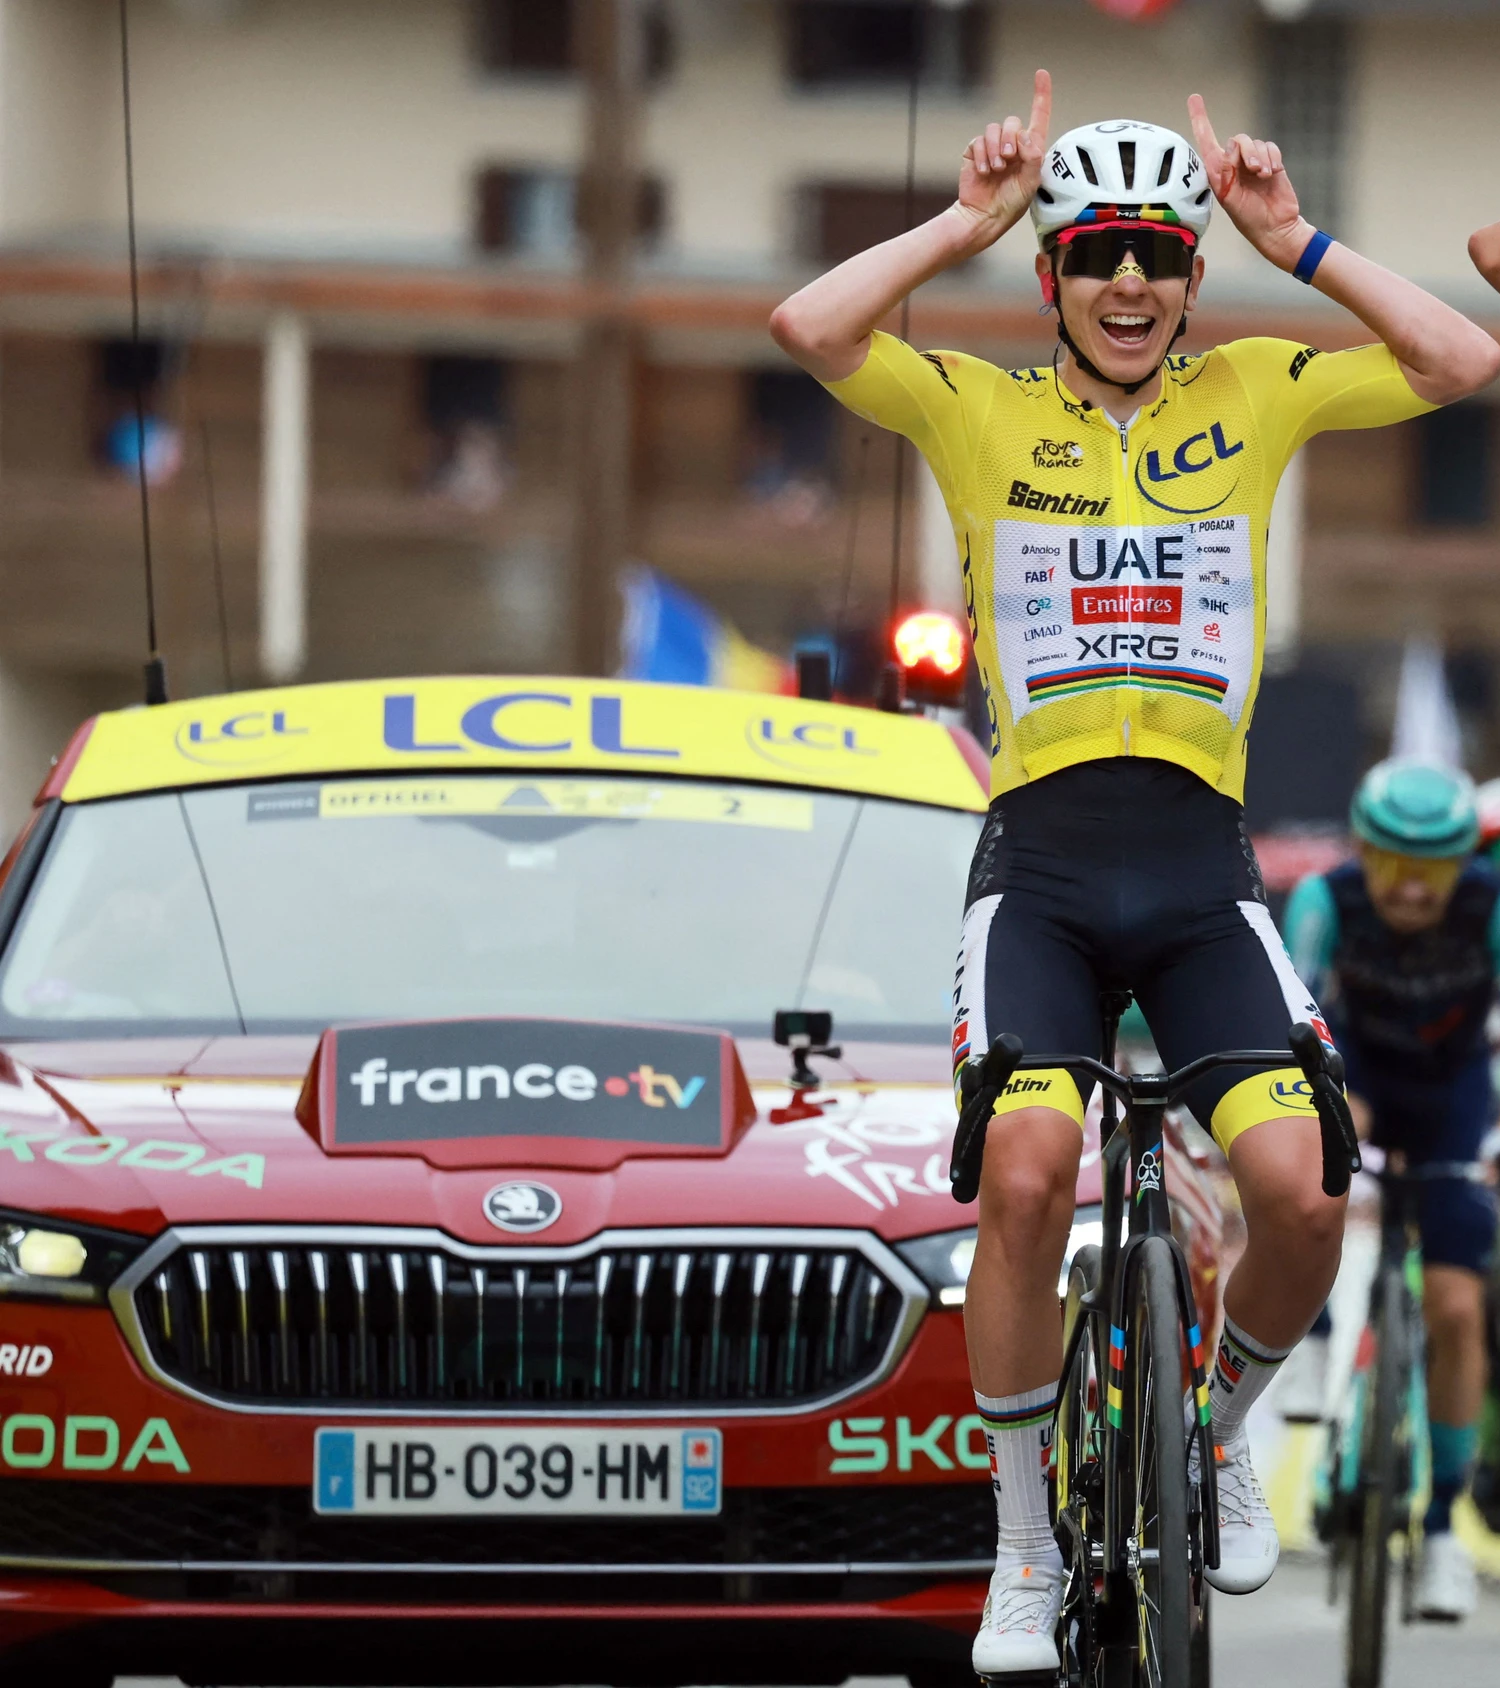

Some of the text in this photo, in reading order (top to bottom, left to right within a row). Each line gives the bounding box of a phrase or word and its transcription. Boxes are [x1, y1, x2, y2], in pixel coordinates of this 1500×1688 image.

[1146, 421, 1244, 483] LCL
[1007, 480, 1111, 517] Santini
[1198, 519, 1235, 533] POGACAR
[1029, 545, 1061, 557] Analog
[1069, 535, 1184, 581] UAE
[1203, 546, 1231, 554] COLNAGO
[1082, 596, 1173, 616] Emirates
[1210, 599, 1230, 616] IHC
[1075, 634, 1180, 661] XRG
[188, 711, 309, 744] LCL
[383, 692, 681, 758] LCL
[760, 718, 879, 757] LCL
[0, 1343, 54, 1378] RID
